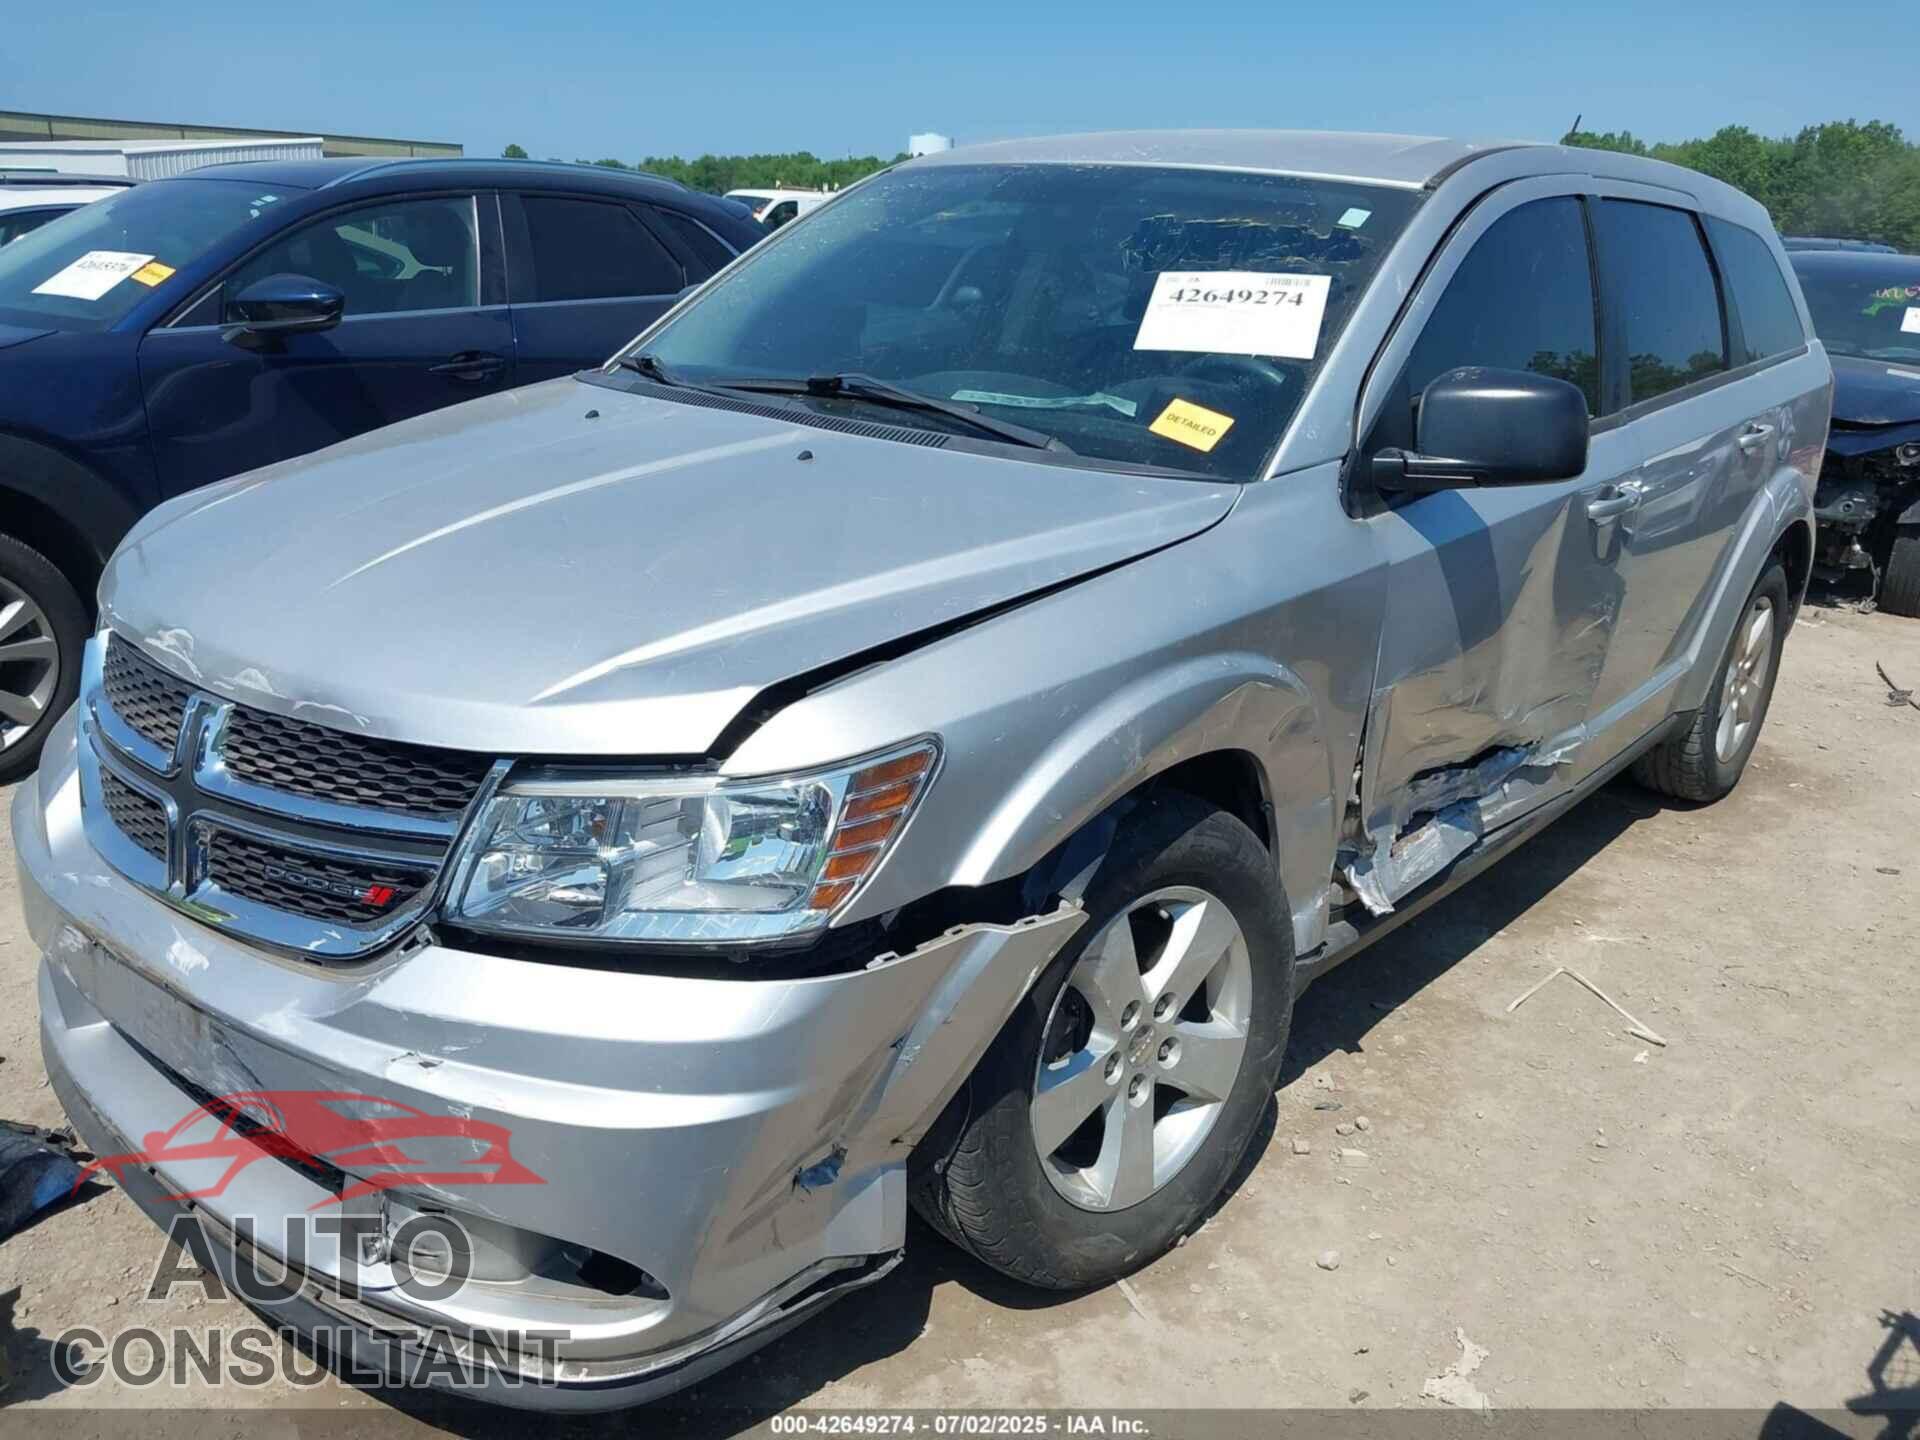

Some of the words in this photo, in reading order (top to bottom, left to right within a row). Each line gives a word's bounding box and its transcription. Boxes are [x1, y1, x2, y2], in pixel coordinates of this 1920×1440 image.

[1169, 288, 1304, 306] 42649274
[1166, 412, 1217, 437] DETAILED
[264, 864, 370, 899] DODGE
